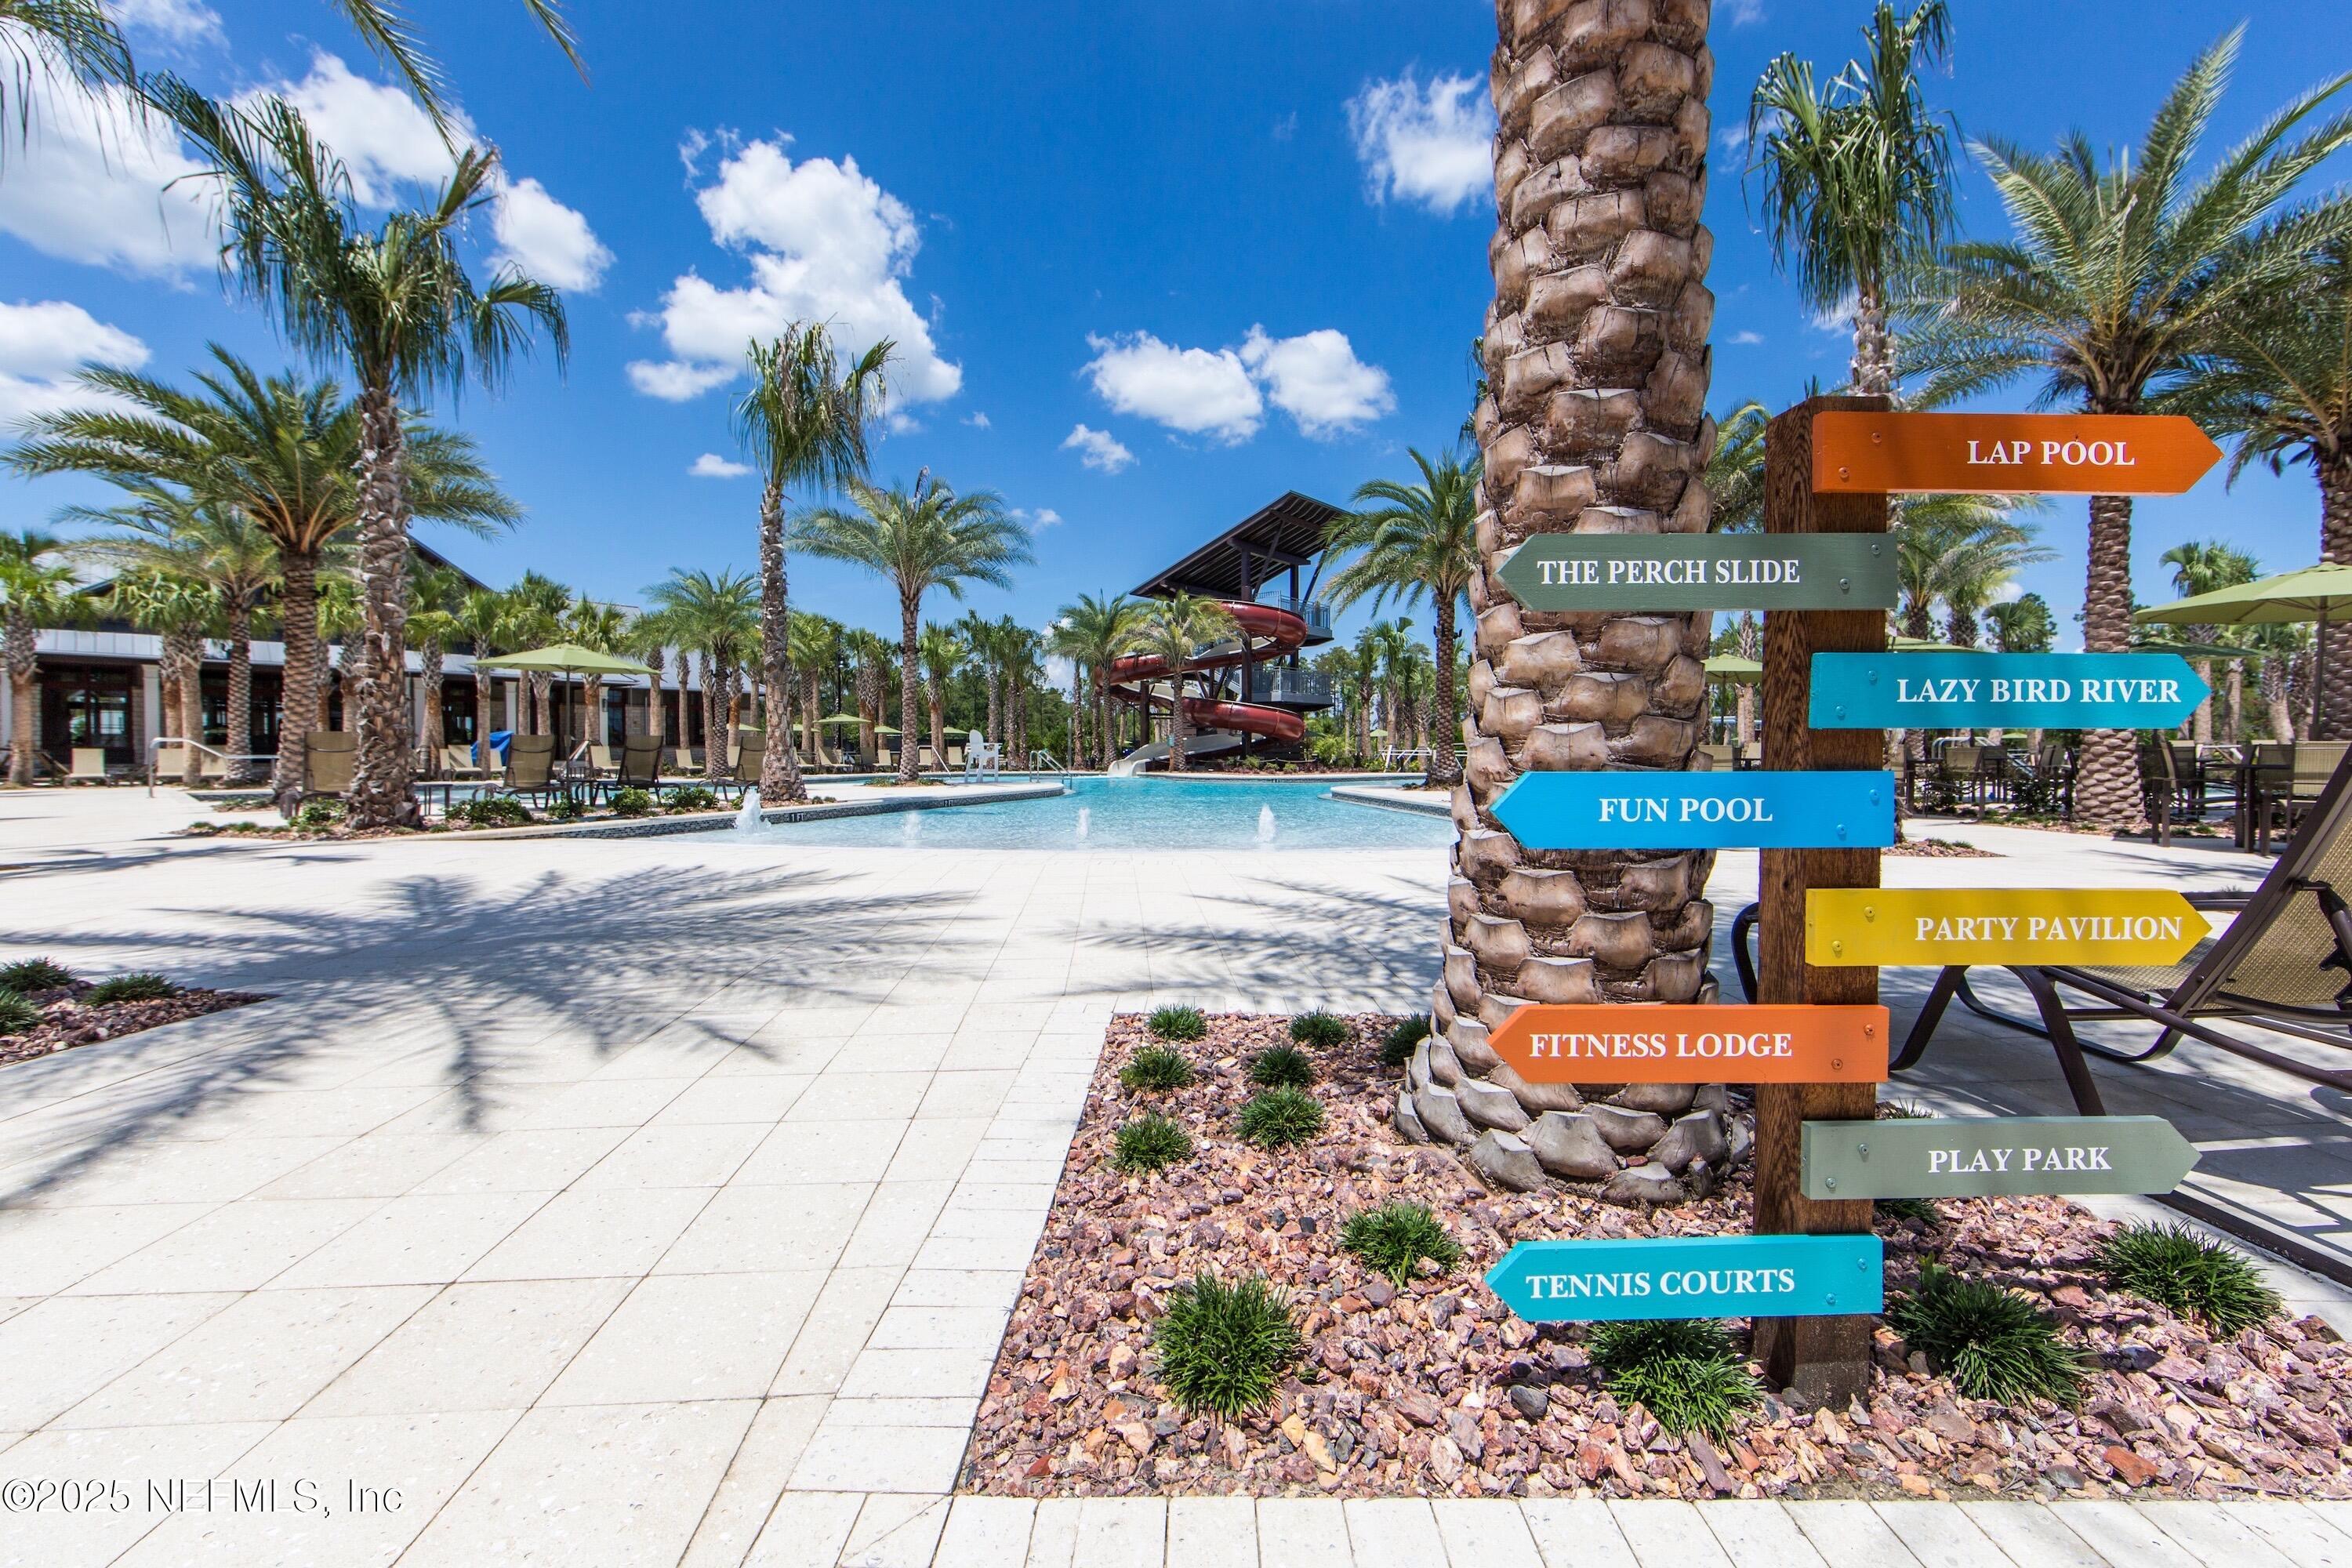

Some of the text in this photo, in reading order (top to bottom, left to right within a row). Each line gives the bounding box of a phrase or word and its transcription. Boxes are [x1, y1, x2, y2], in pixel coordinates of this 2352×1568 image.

[1966, 440, 2136, 466] LAP POOL
[1536, 558, 1801, 586] THE PERCH SLIDE
[1896, 678, 2182, 704] LAZY BIRD RIVER
[797, 812, 804, 822] FT
[1598, 797, 1773, 823] FUN POOL
[1915, 916, 2183, 942] PARTY PAVILION
[1529, 1033, 1793, 1058] FITNESS LODGE
[1927, 1145, 2113, 1174] PLAY PARK
[1525, 1268, 1796, 1300] TENNIS COURTS
